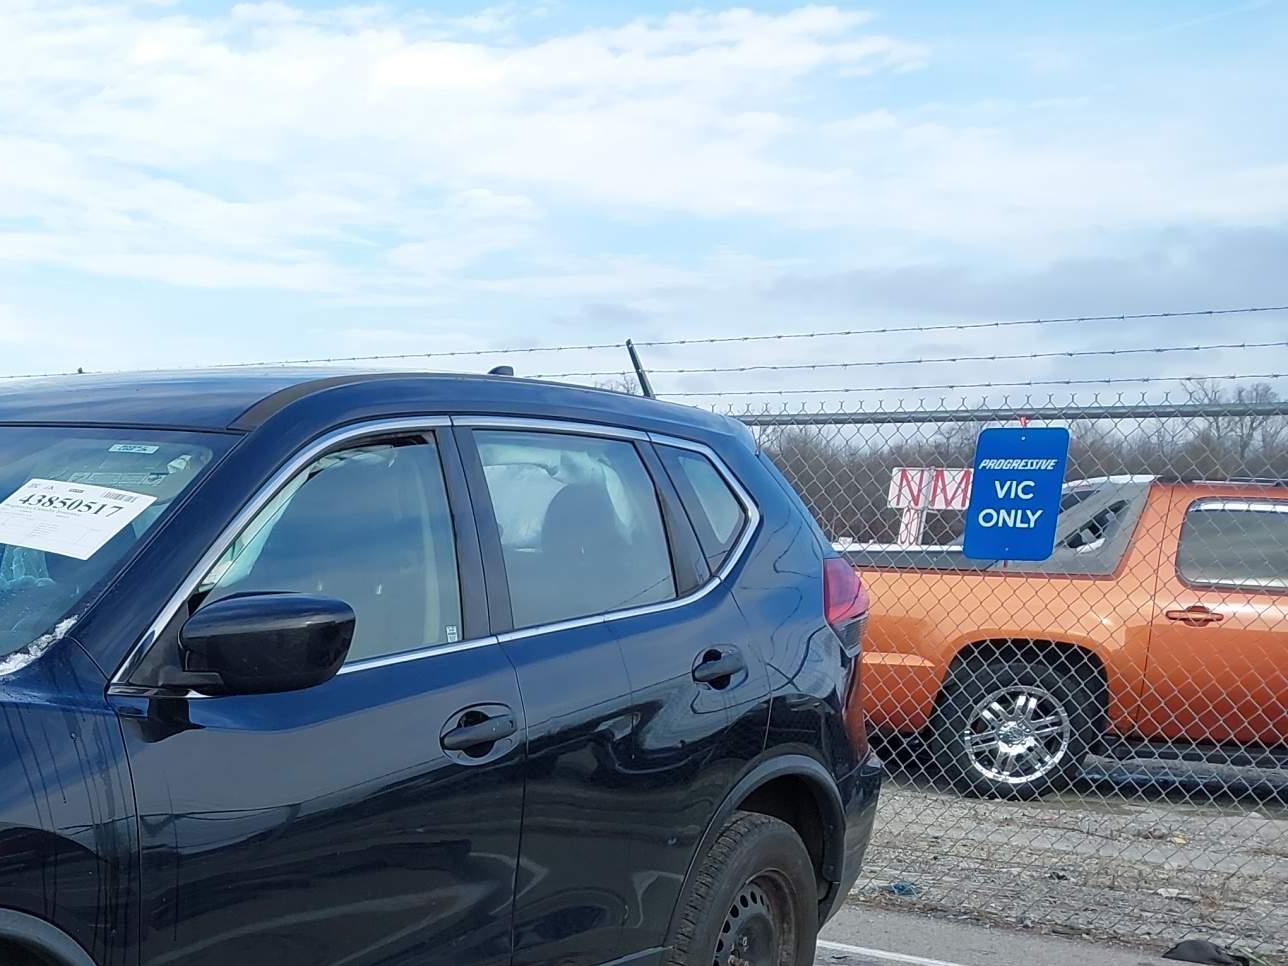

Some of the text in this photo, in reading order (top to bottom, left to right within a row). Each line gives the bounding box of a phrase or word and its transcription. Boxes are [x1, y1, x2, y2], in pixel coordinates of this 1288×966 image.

[978, 459, 1058, 470] PROGRESSIVE
[994, 480, 1036, 499] VIC
[18, 492, 125, 518] 43850517
[978, 508, 1044, 528] ONLY
